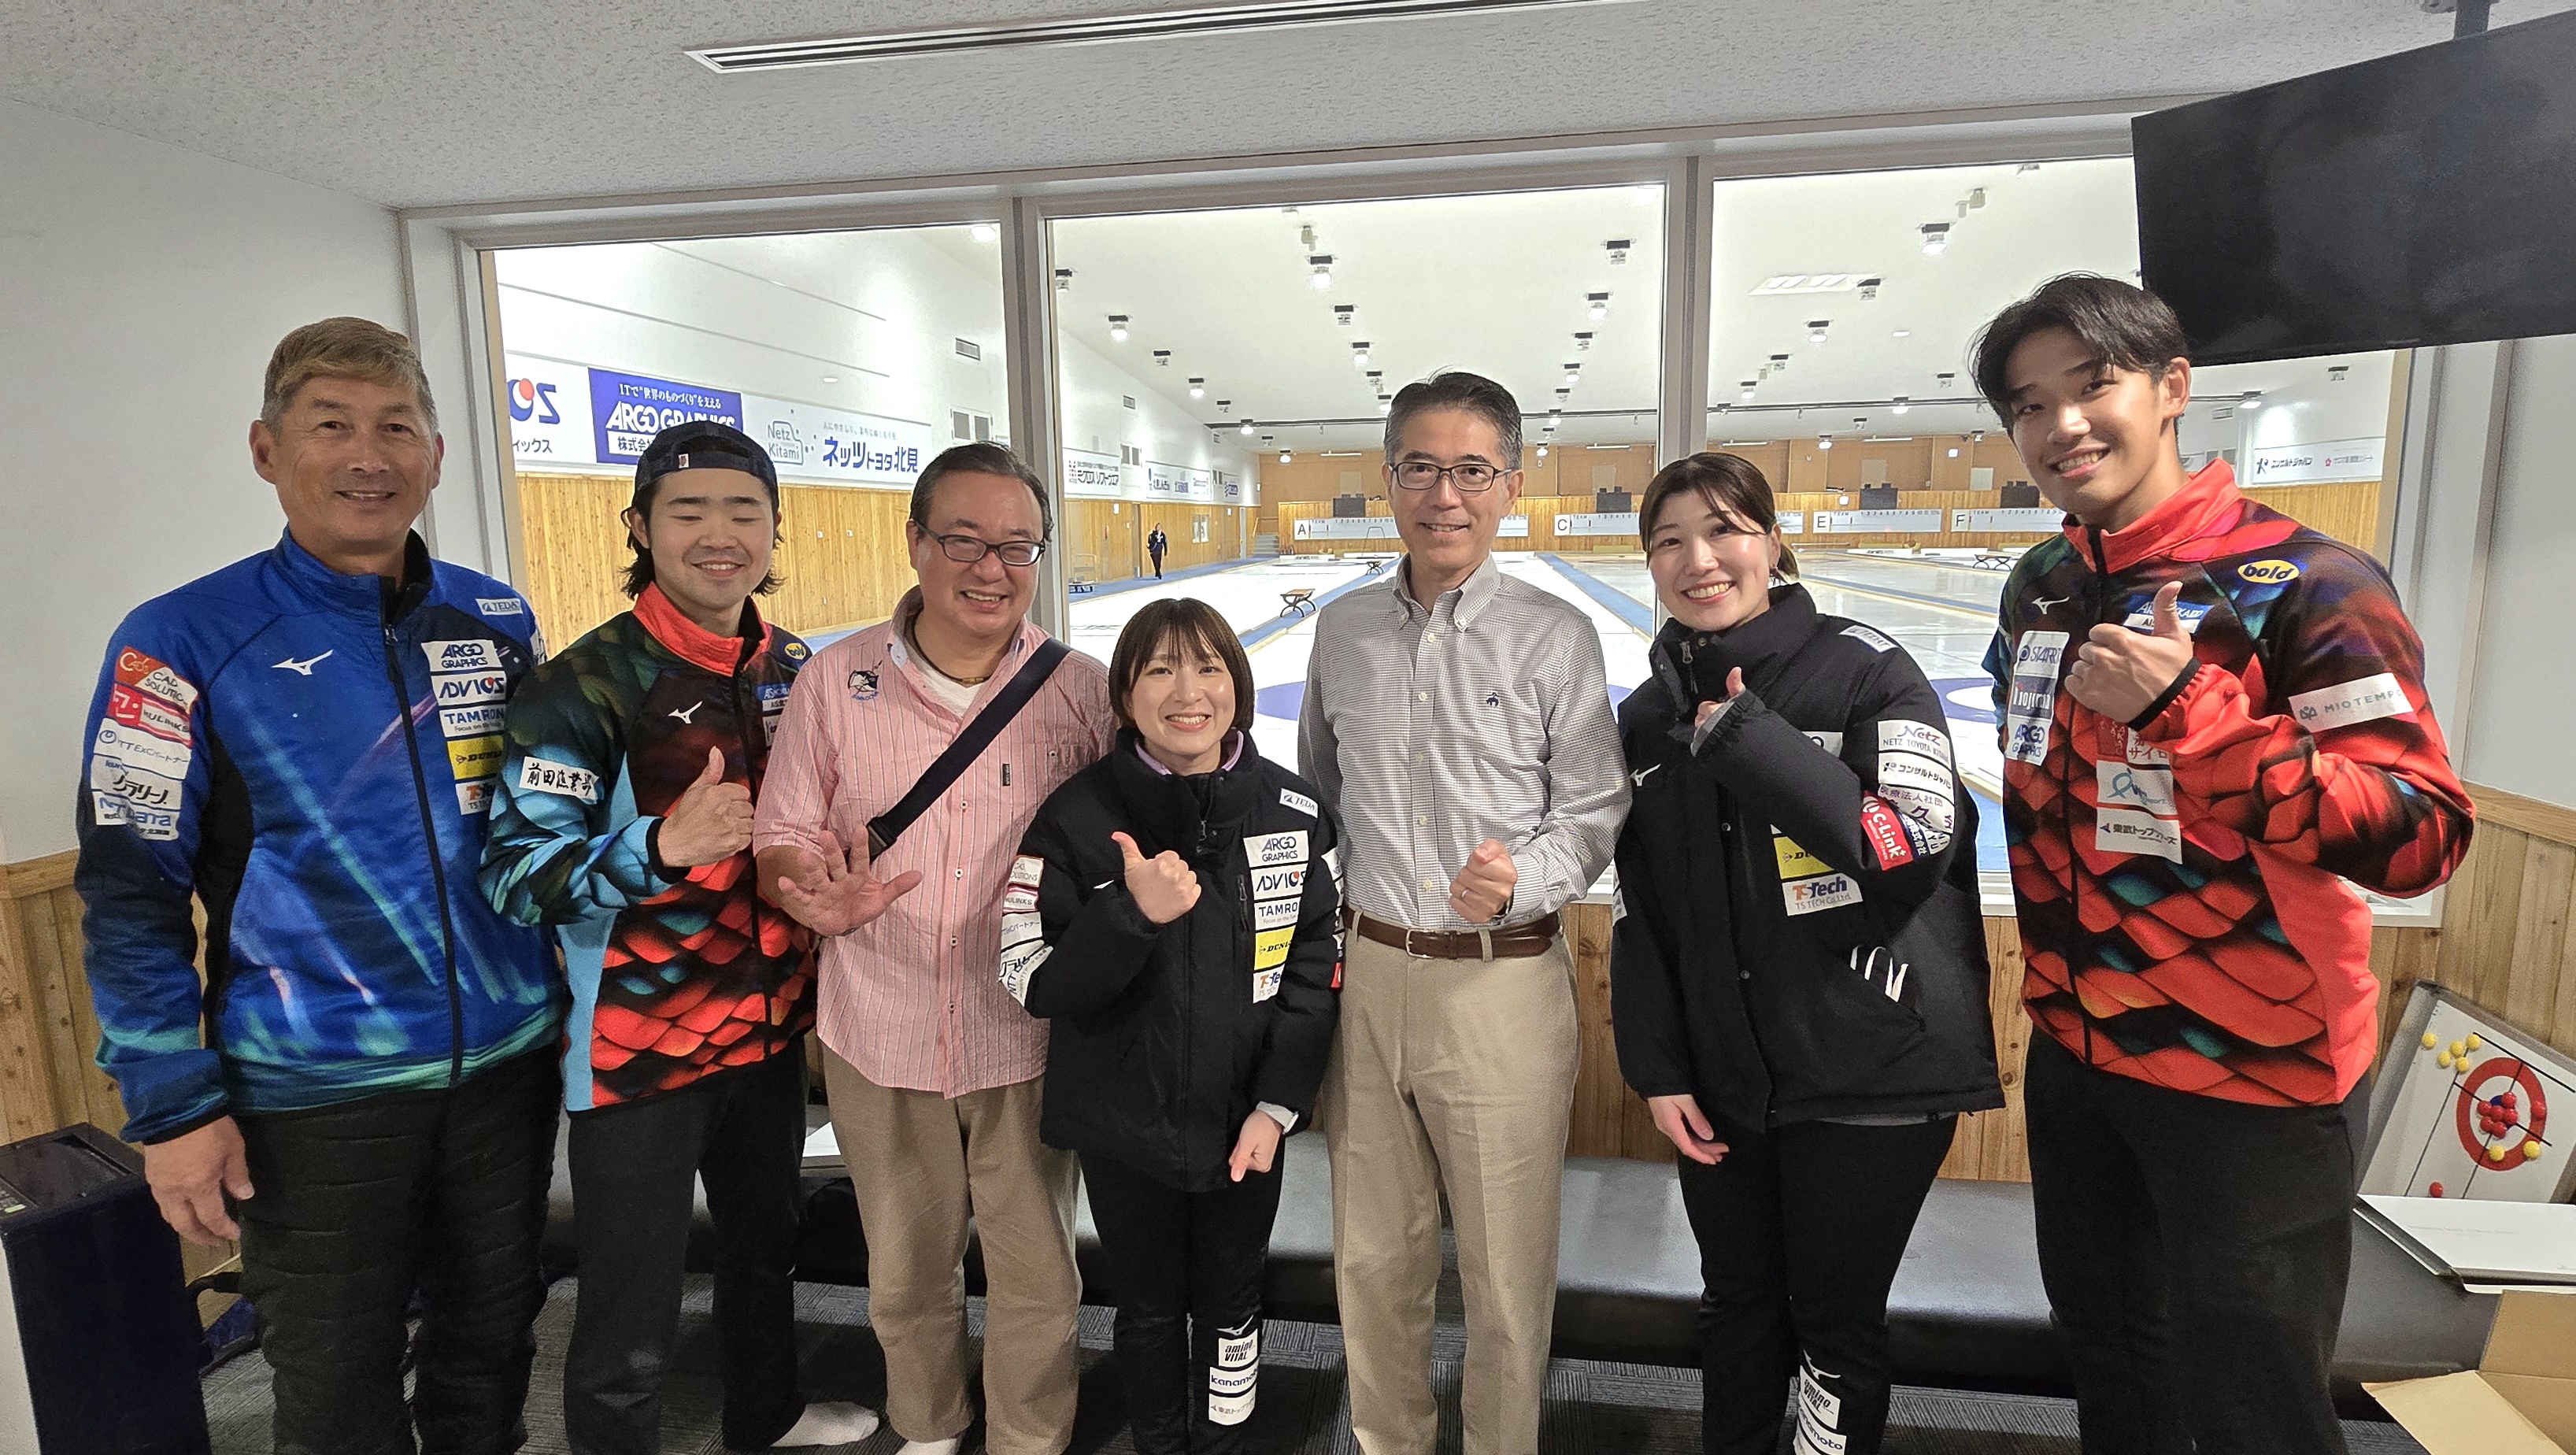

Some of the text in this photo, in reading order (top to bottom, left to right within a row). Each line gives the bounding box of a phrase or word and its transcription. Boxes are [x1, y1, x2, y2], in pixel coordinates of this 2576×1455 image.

[605, 401, 659, 434] ARGO
[768, 424, 792, 442] Netz
[768, 442, 800, 461] Kitami
[823, 436, 919, 473] ネッツトヨタ北見
[1557, 519, 1567, 531] C
[1817, 516, 1827, 528] E
[1956, 514, 1966, 527] F
[1297, 524, 1306, 535] A
[2244, 565, 2294, 579] bold
[441, 643, 484, 658] ARGO
[441, 657, 488, 668] GRAPHICS
[153, 672, 178, 687] CAD
[439, 677, 505, 699] ADVICS
[444, 709, 505, 724] TAMRON
[1897, 725, 1941, 746] Netz
[2015, 724, 2045, 743] ARGO
[1907, 739, 1931, 753] TOYOTA
[1261, 836, 1297, 852] ARGO
[1262, 850, 1298, 862] GRAPHICS
[1224, 1339, 1254, 1353] amino
[1223, 1350, 1248, 1362] VITAL
